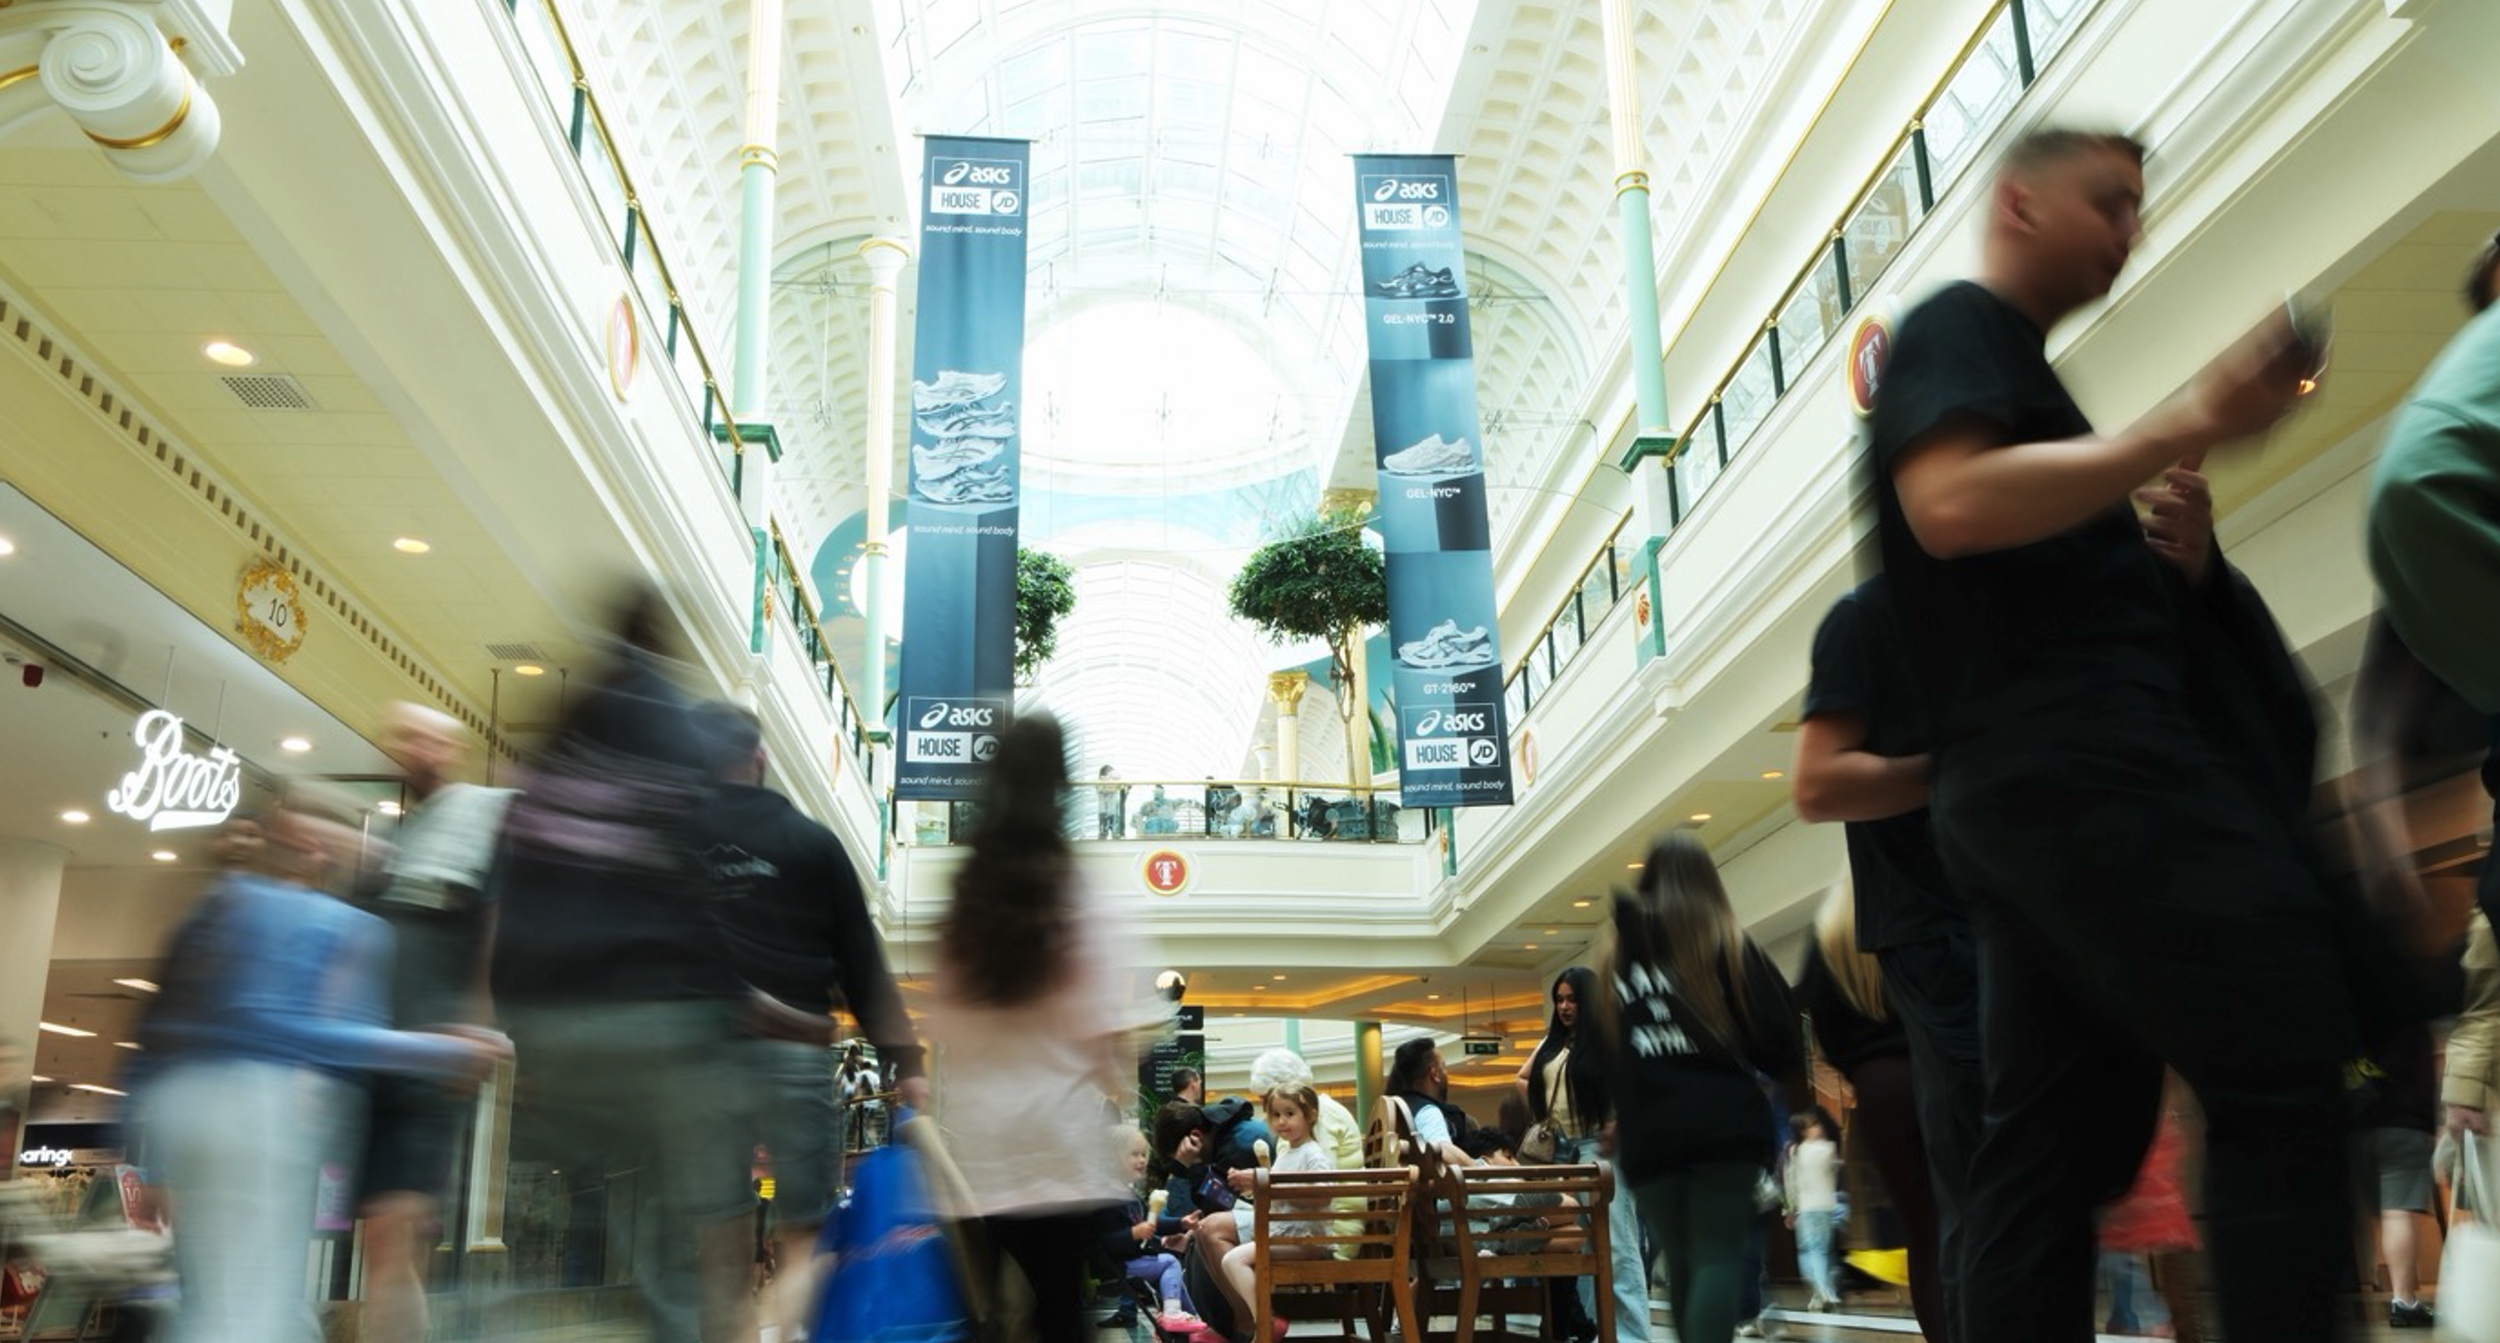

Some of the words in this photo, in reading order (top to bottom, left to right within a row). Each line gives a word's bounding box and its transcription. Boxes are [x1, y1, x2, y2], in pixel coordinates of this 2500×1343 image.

[969, 166, 1010, 184] asics
[1399, 183, 1438, 199] asics
[941, 192, 981, 209] HOUSE
[996, 197, 1015, 208] JD
[1374, 209, 1413, 225] HOUSE
[926, 225, 951, 233] sound
[974, 226, 1000, 235] sound
[1001, 227, 1022, 236] body
[1438, 313, 1455, 325] 2.0
[993, 526, 1014, 537] body
[268, 597, 287, 628] 10
[948, 707, 993, 726] asics
[1443, 713, 1485, 732] asics
[917, 738, 961, 757] HOUSE
[977, 741, 997, 755] JD
[1416, 744, 1459, 763] HOUSE
[1474, 745, 1494, 759] JD
[108, 709, 240, 832] Boots
[900, 776, 929, 785] sound
[1404, 784, 1430, 793] sound
[1456, 781, 1482, 791] sound
[1484, 780, 1506, 790] body
